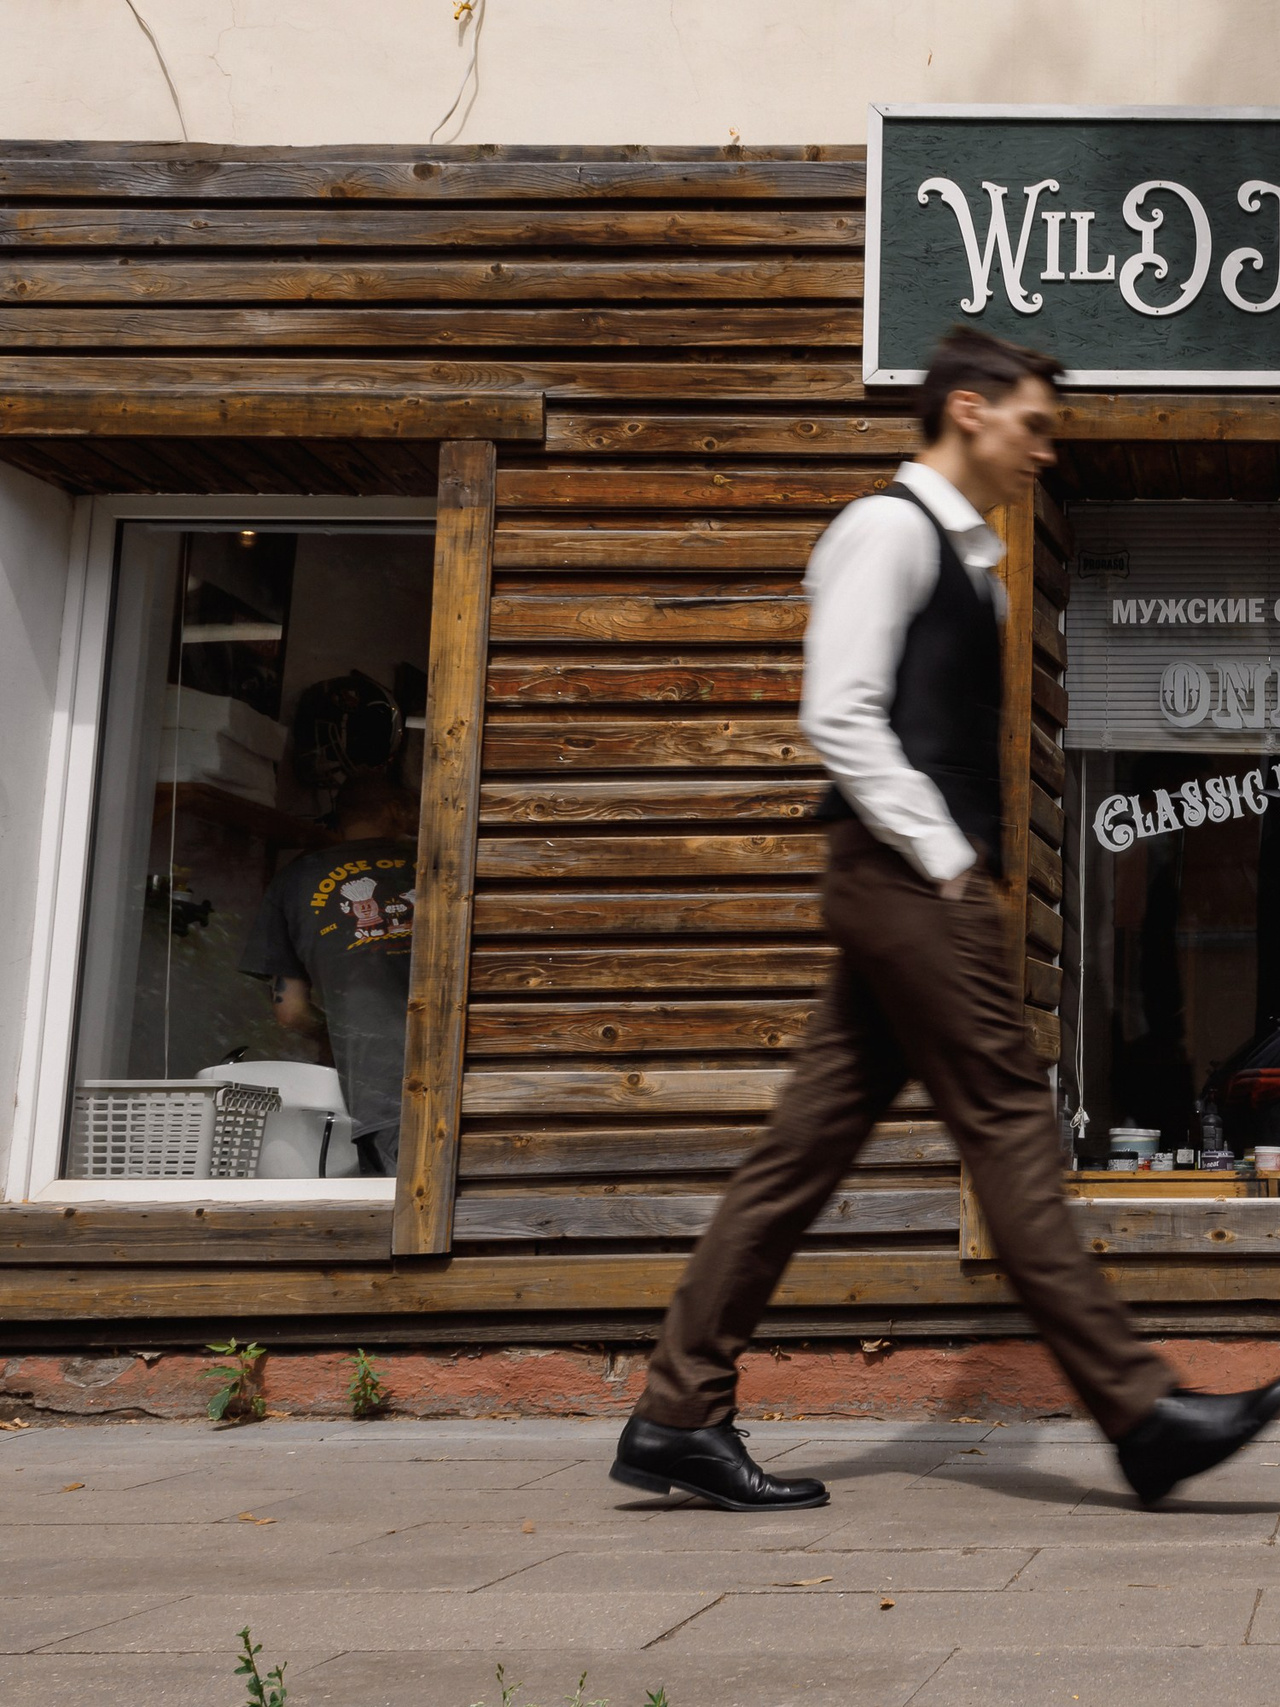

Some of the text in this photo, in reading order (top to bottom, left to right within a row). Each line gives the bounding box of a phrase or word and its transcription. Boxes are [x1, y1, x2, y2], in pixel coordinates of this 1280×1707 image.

[917, 177, 1212, 315] WILD
[1112, 598, 1265, 624] МУЖСКИЕ
[1092, 768, 1269, 853] CLASSIC
[310, 859, 406, 907] HOUSE OF
